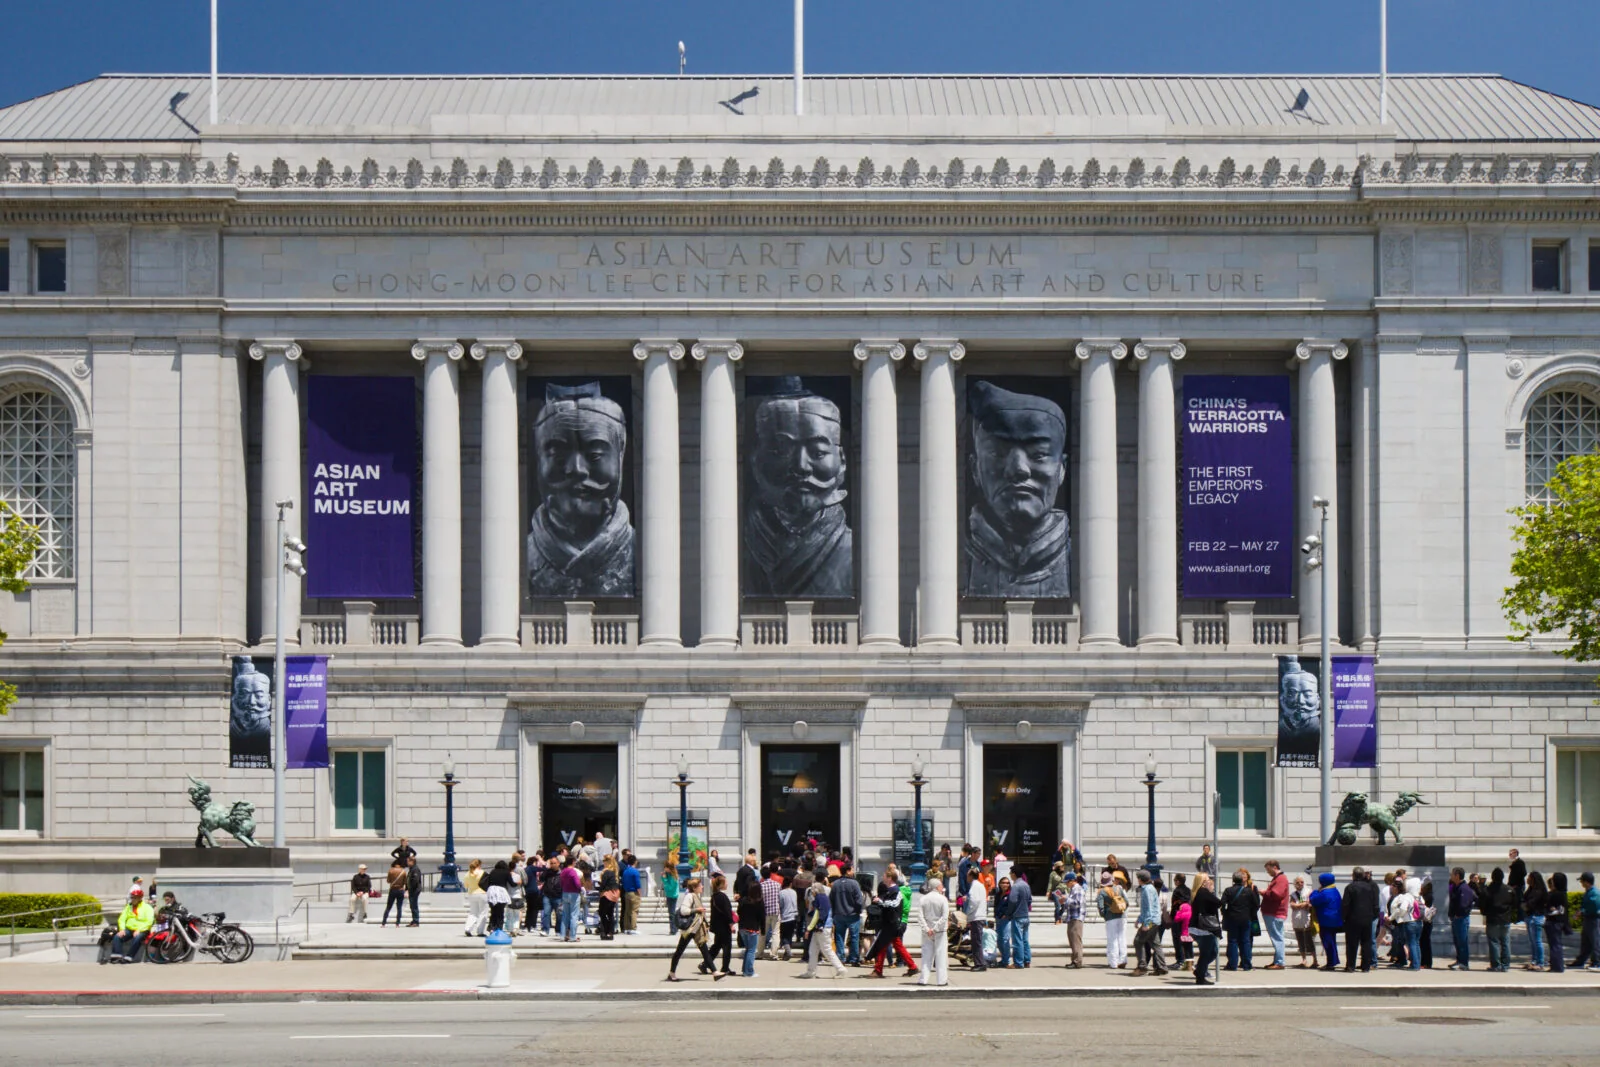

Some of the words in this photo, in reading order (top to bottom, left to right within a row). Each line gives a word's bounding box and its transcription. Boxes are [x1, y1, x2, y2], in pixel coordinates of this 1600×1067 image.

[586, 242, 706, 266] ASIAN
[729, 242, 805, 266] ART
[826, 242, 1014, 266] MUSEUM
[332, 274, 566, 293] CHONG-MOON
[587, 274, 632, 293] LEE
[652, 274, 770, 293] CENTER
[789, 274, 847, 293] FOR
[862, 274, 954, 293] ASIAN
[970, 274, 1025, 293] ART
[1042, 274, 1105, 292] AND
[1123, 274, 1264, 292] CULTURE
[1188, 398, 1247, 409] CHINA'S
[1188, 410, 1285, 421] TERRACOTTA
[1188, 422, 1268, 433] WARRIORS
[314, 463, 380, 480] ASIAN
[1188, 467, 1214, 478] THE
[1217, 466, 1253, 477] FIRST
[314, 481, 358, 497] ART
[1189, 480, 1263, 491] EMPEROR'S
[1189, 493, 1239, 505] LEGACY
[314, 499, 410, 515] MUSEUM
[1188, 541, 1210, 551] FEB
[1212, 541, 1226, 551] 22
[1241, 541, 1263, 551] MAY
[1266, 541, 1280, 551] 27
[1188, 563, 1271, 574] www.asianart.org
[558, 787, 581, 795] Priority
